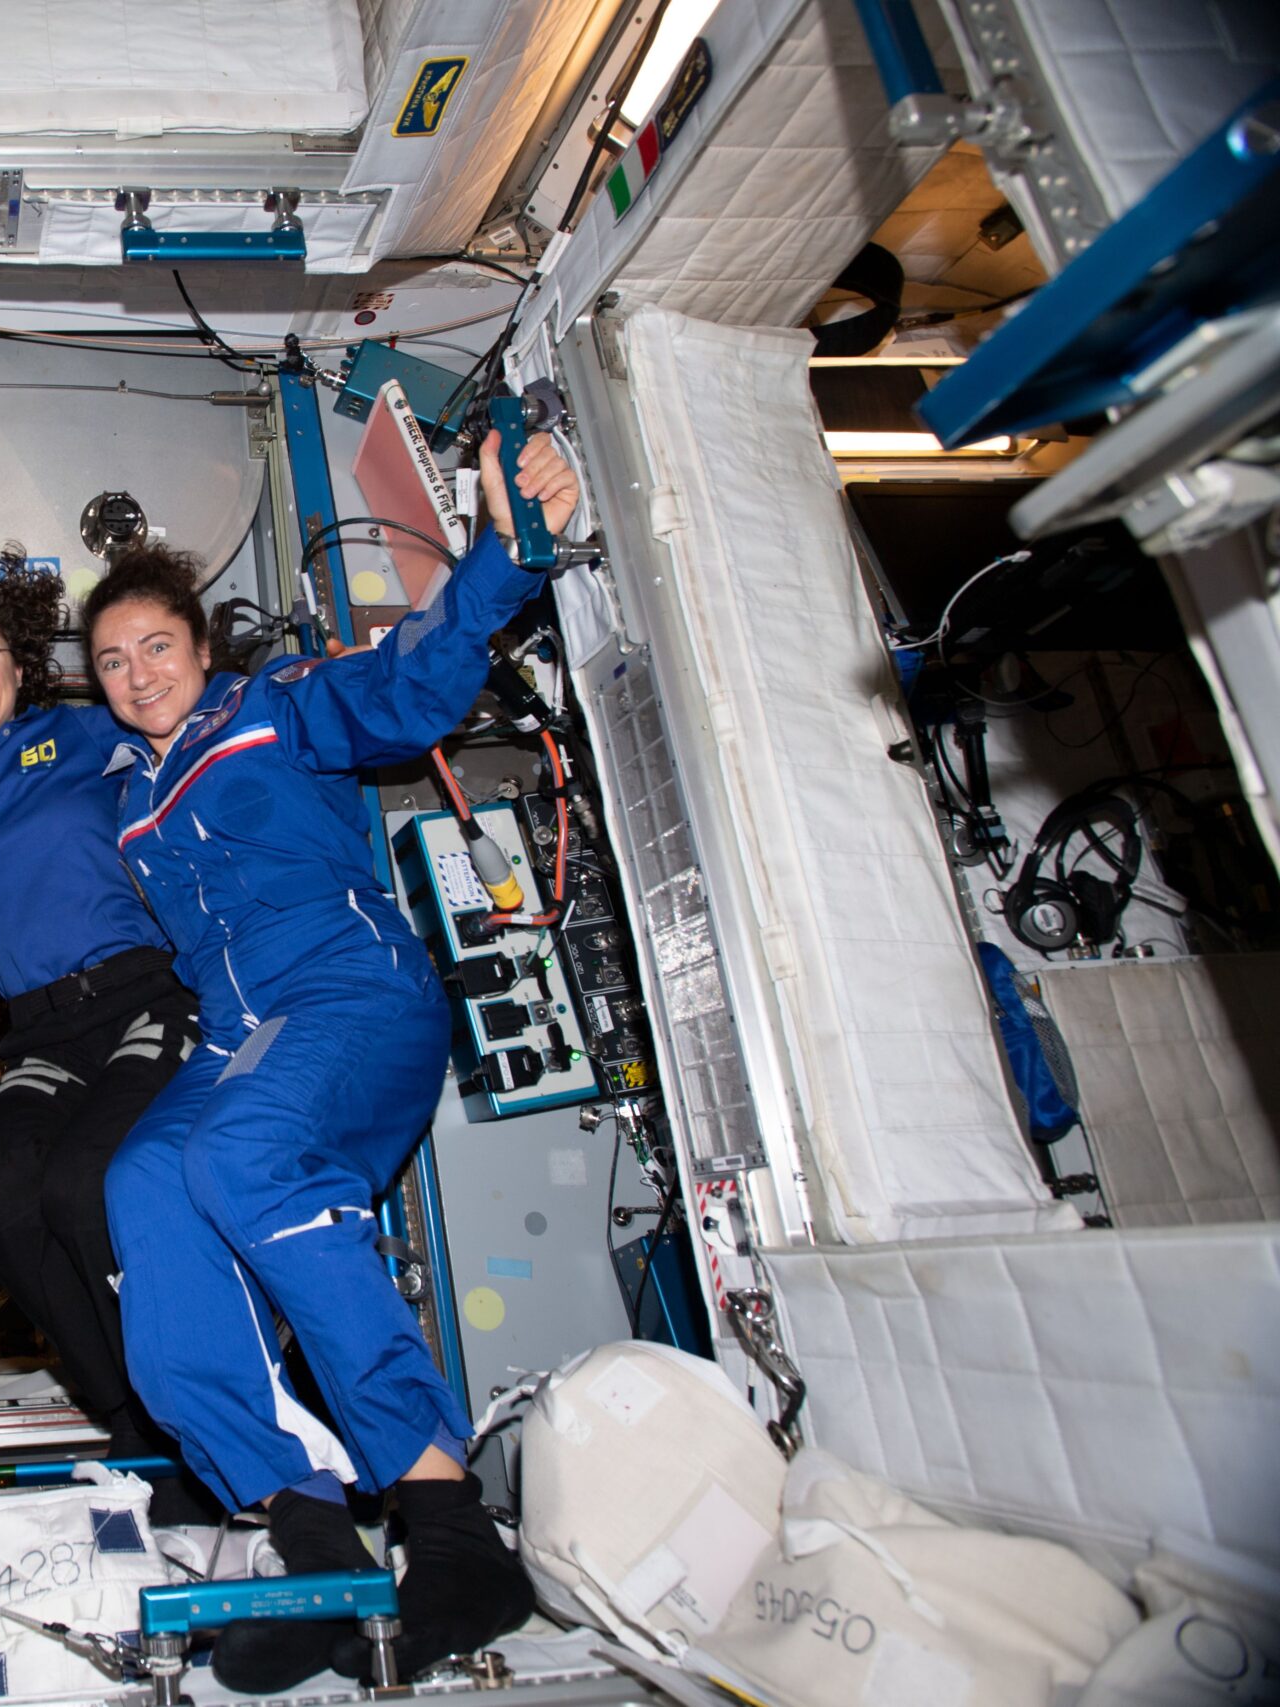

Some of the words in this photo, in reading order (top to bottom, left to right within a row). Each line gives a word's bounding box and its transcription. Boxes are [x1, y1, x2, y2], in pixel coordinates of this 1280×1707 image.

[403, 414, 422, 445] EMER:
[416, 446, 438, 484] Depress
[433, 484, 444, 494] &
[437, 494, 452, 514] Fire
[447, 515, 458, 528] 1a
[461, 859, 475, 897] ATTENTION
[570, 943, 581, 959] VDC
[575, 962, 585, 975] 120
